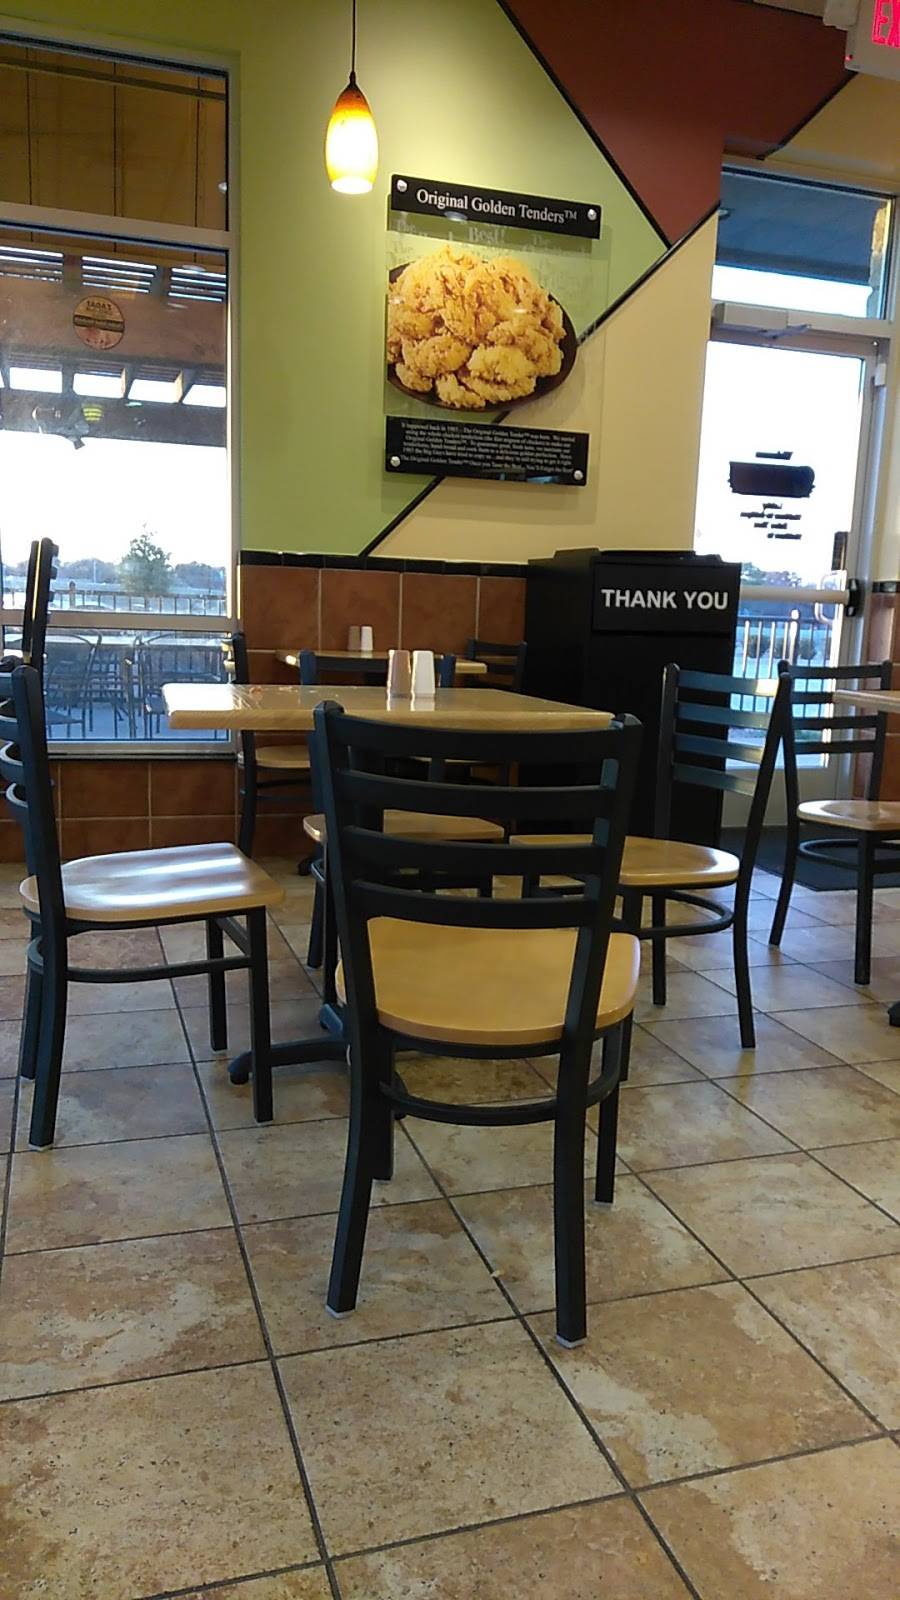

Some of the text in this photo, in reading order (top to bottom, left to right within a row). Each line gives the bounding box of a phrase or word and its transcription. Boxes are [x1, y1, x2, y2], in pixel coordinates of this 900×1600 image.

[416, 188, 469, 210] Original
[471, 196, 516, 217] Golden
[601, 589, 728, 610] THANK YOU
